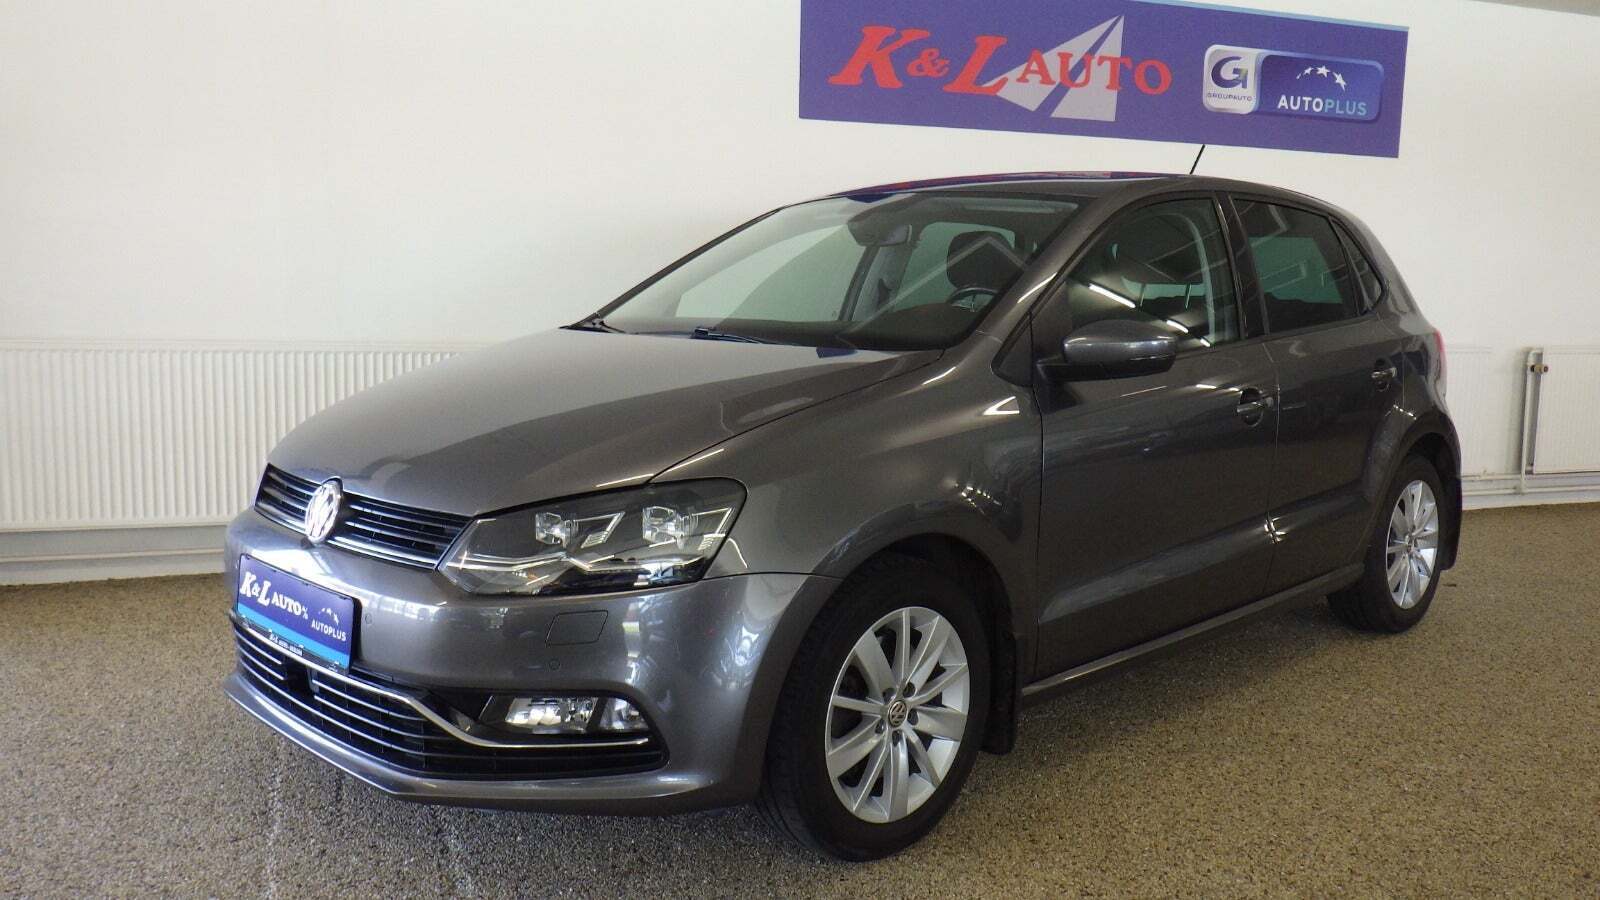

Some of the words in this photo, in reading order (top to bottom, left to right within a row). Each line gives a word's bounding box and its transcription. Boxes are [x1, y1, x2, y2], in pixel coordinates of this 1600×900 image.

[828, 25, 1008, 96] K&L
[1016, 50, 1173, 95] AUTO
[1277, 95, 1367, 116] AUTOPLUS
[239, 571, 271, 606] K&L
[271, 592, 302, 616] AUTO
[311, 619, 347, 642] AUTOPLUS
